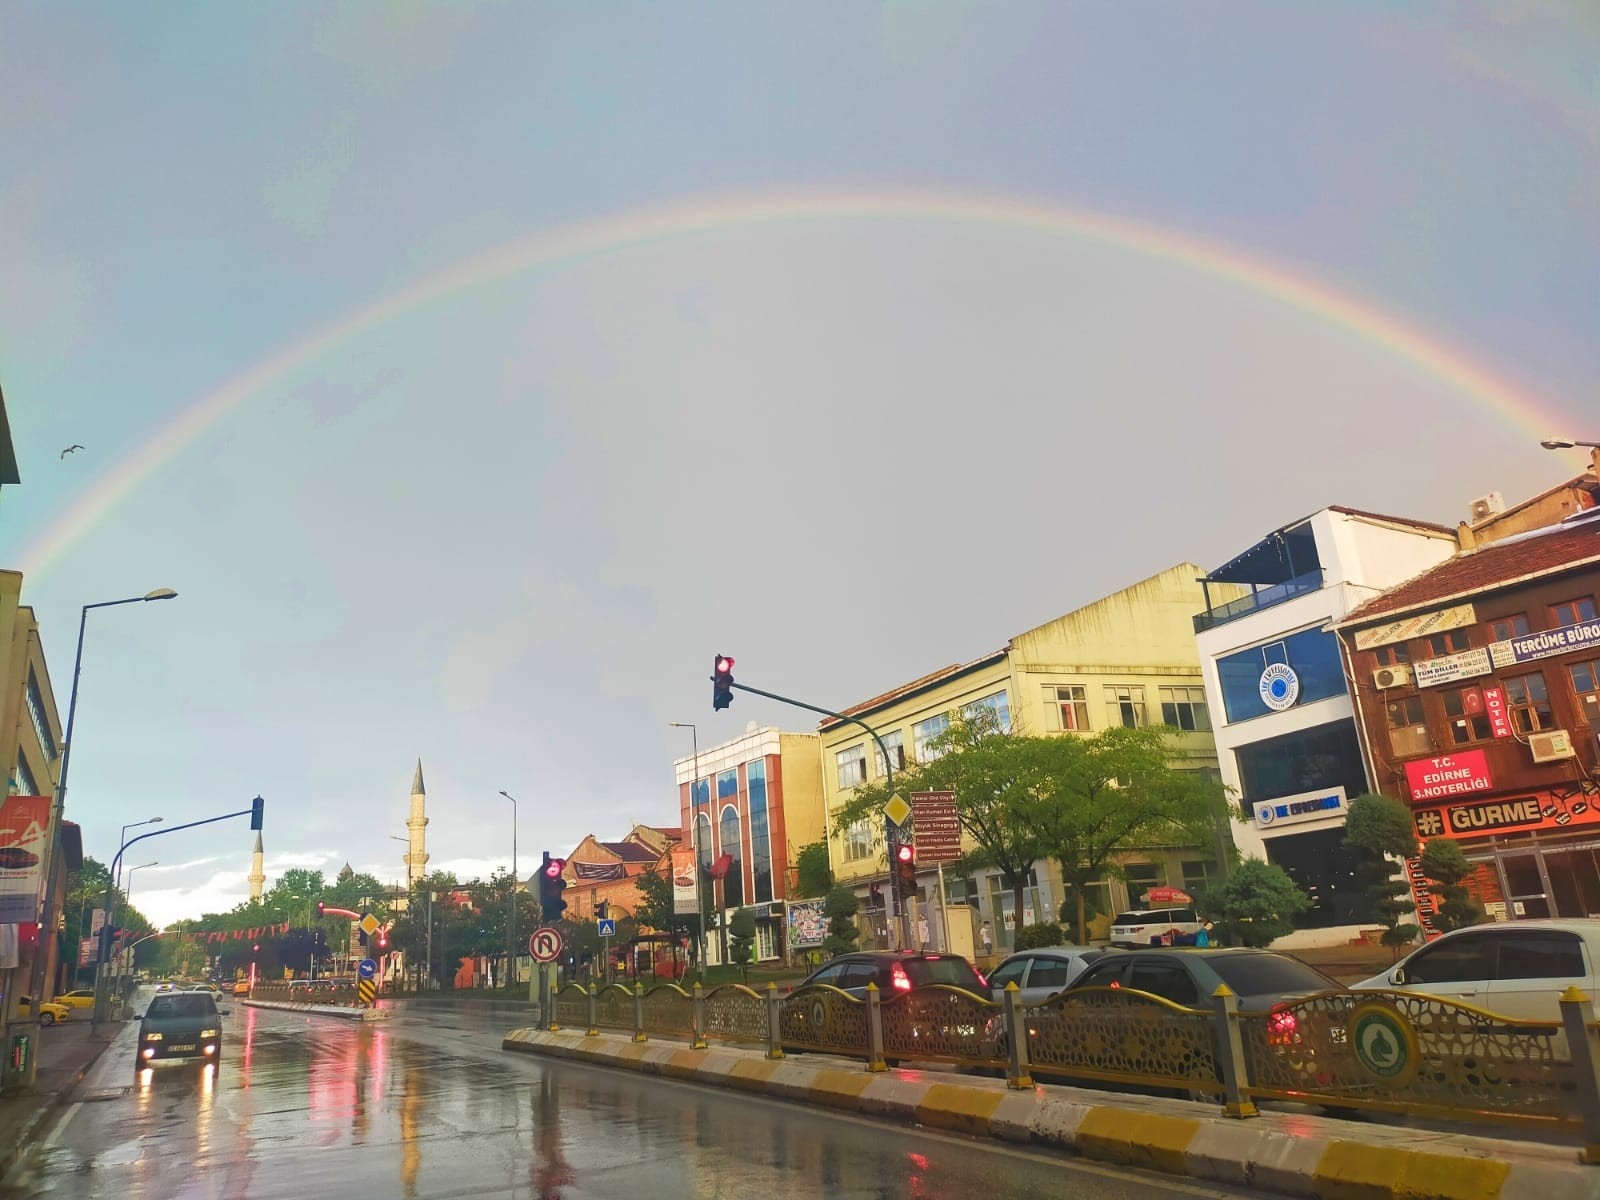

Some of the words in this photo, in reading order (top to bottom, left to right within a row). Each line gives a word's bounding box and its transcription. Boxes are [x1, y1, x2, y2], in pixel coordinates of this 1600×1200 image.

[1513, 632, 1566, 655] TERCÜME
[1566, 624, 1600, 643] BÜRO
[1487, 691, 1507, 736] NOTER
[1423, 768, 1471, 784] EDİRNE
[1432, 758, 1455, 769] T.C.
[1414, 778, 1489, 799] 3.NOTERLİĞİ
[1452, 800, 1541, 829] GURME
